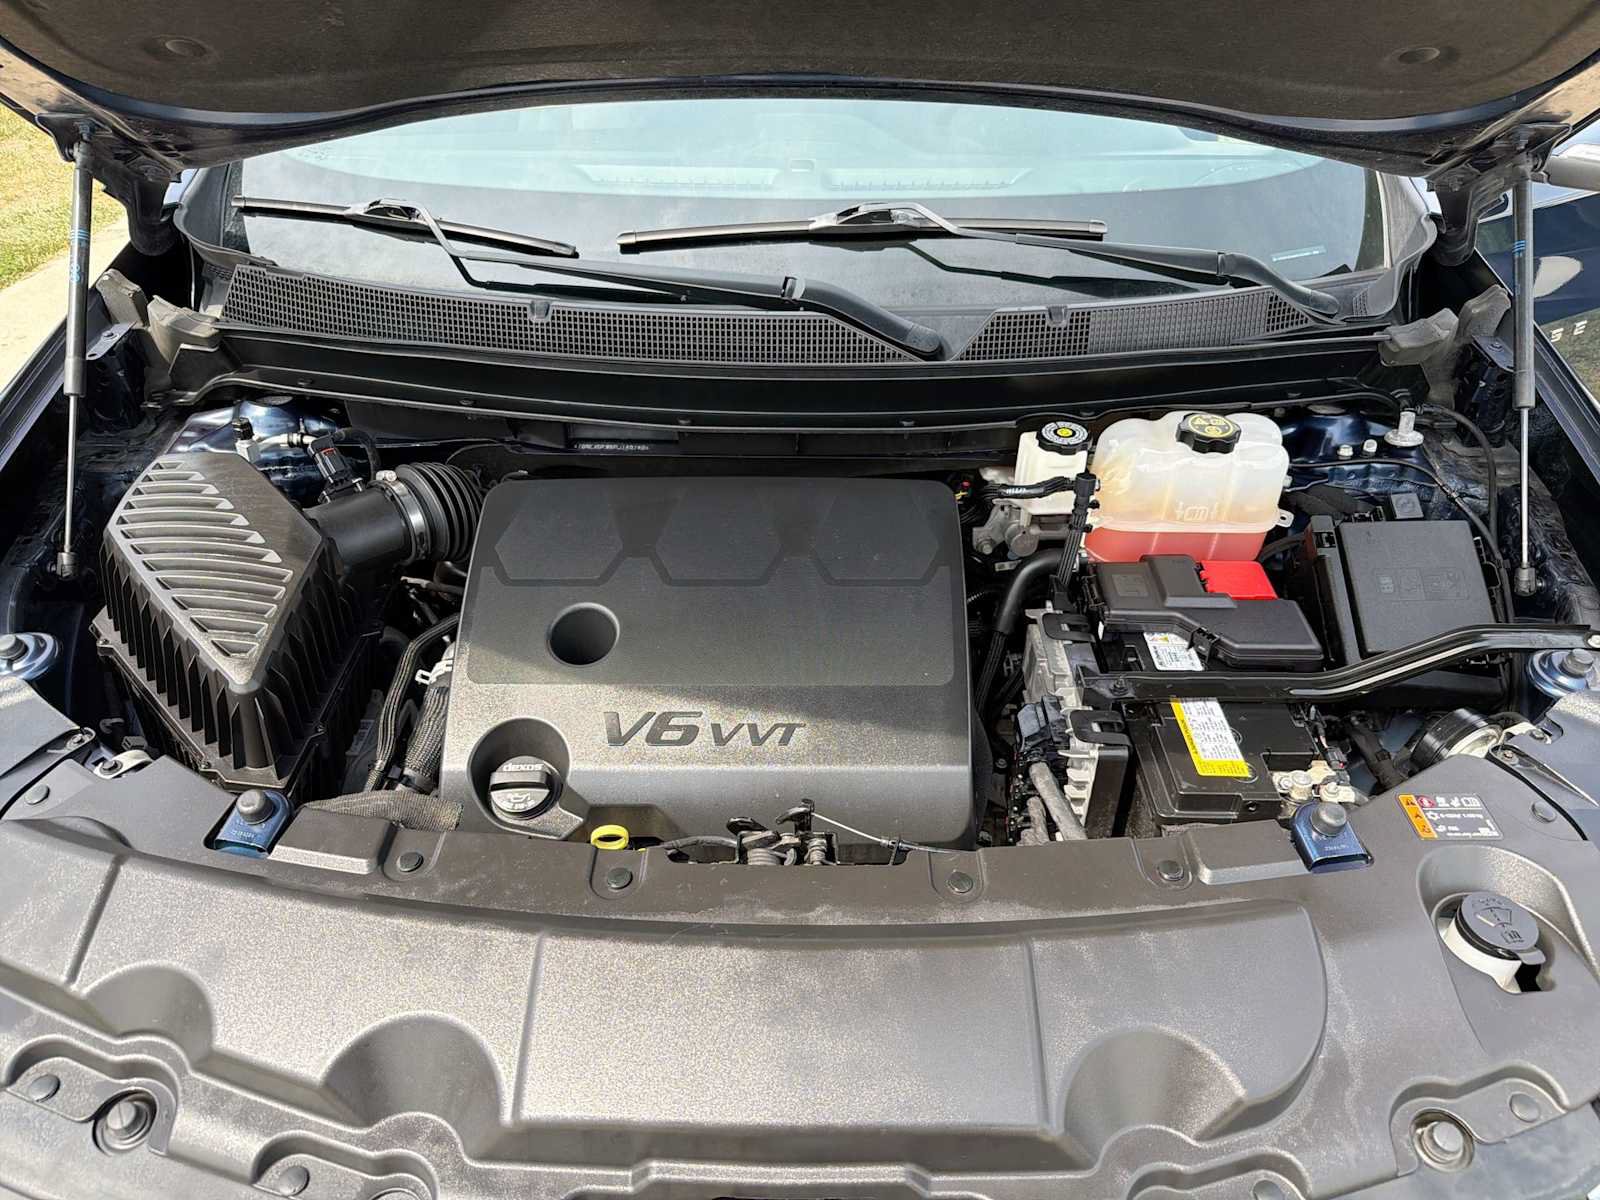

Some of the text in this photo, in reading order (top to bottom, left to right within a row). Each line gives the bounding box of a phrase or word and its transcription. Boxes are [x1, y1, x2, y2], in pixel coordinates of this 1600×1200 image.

[603, 711, 807, 747] V6 VVT
[502, 762, 545, 772] dexos
